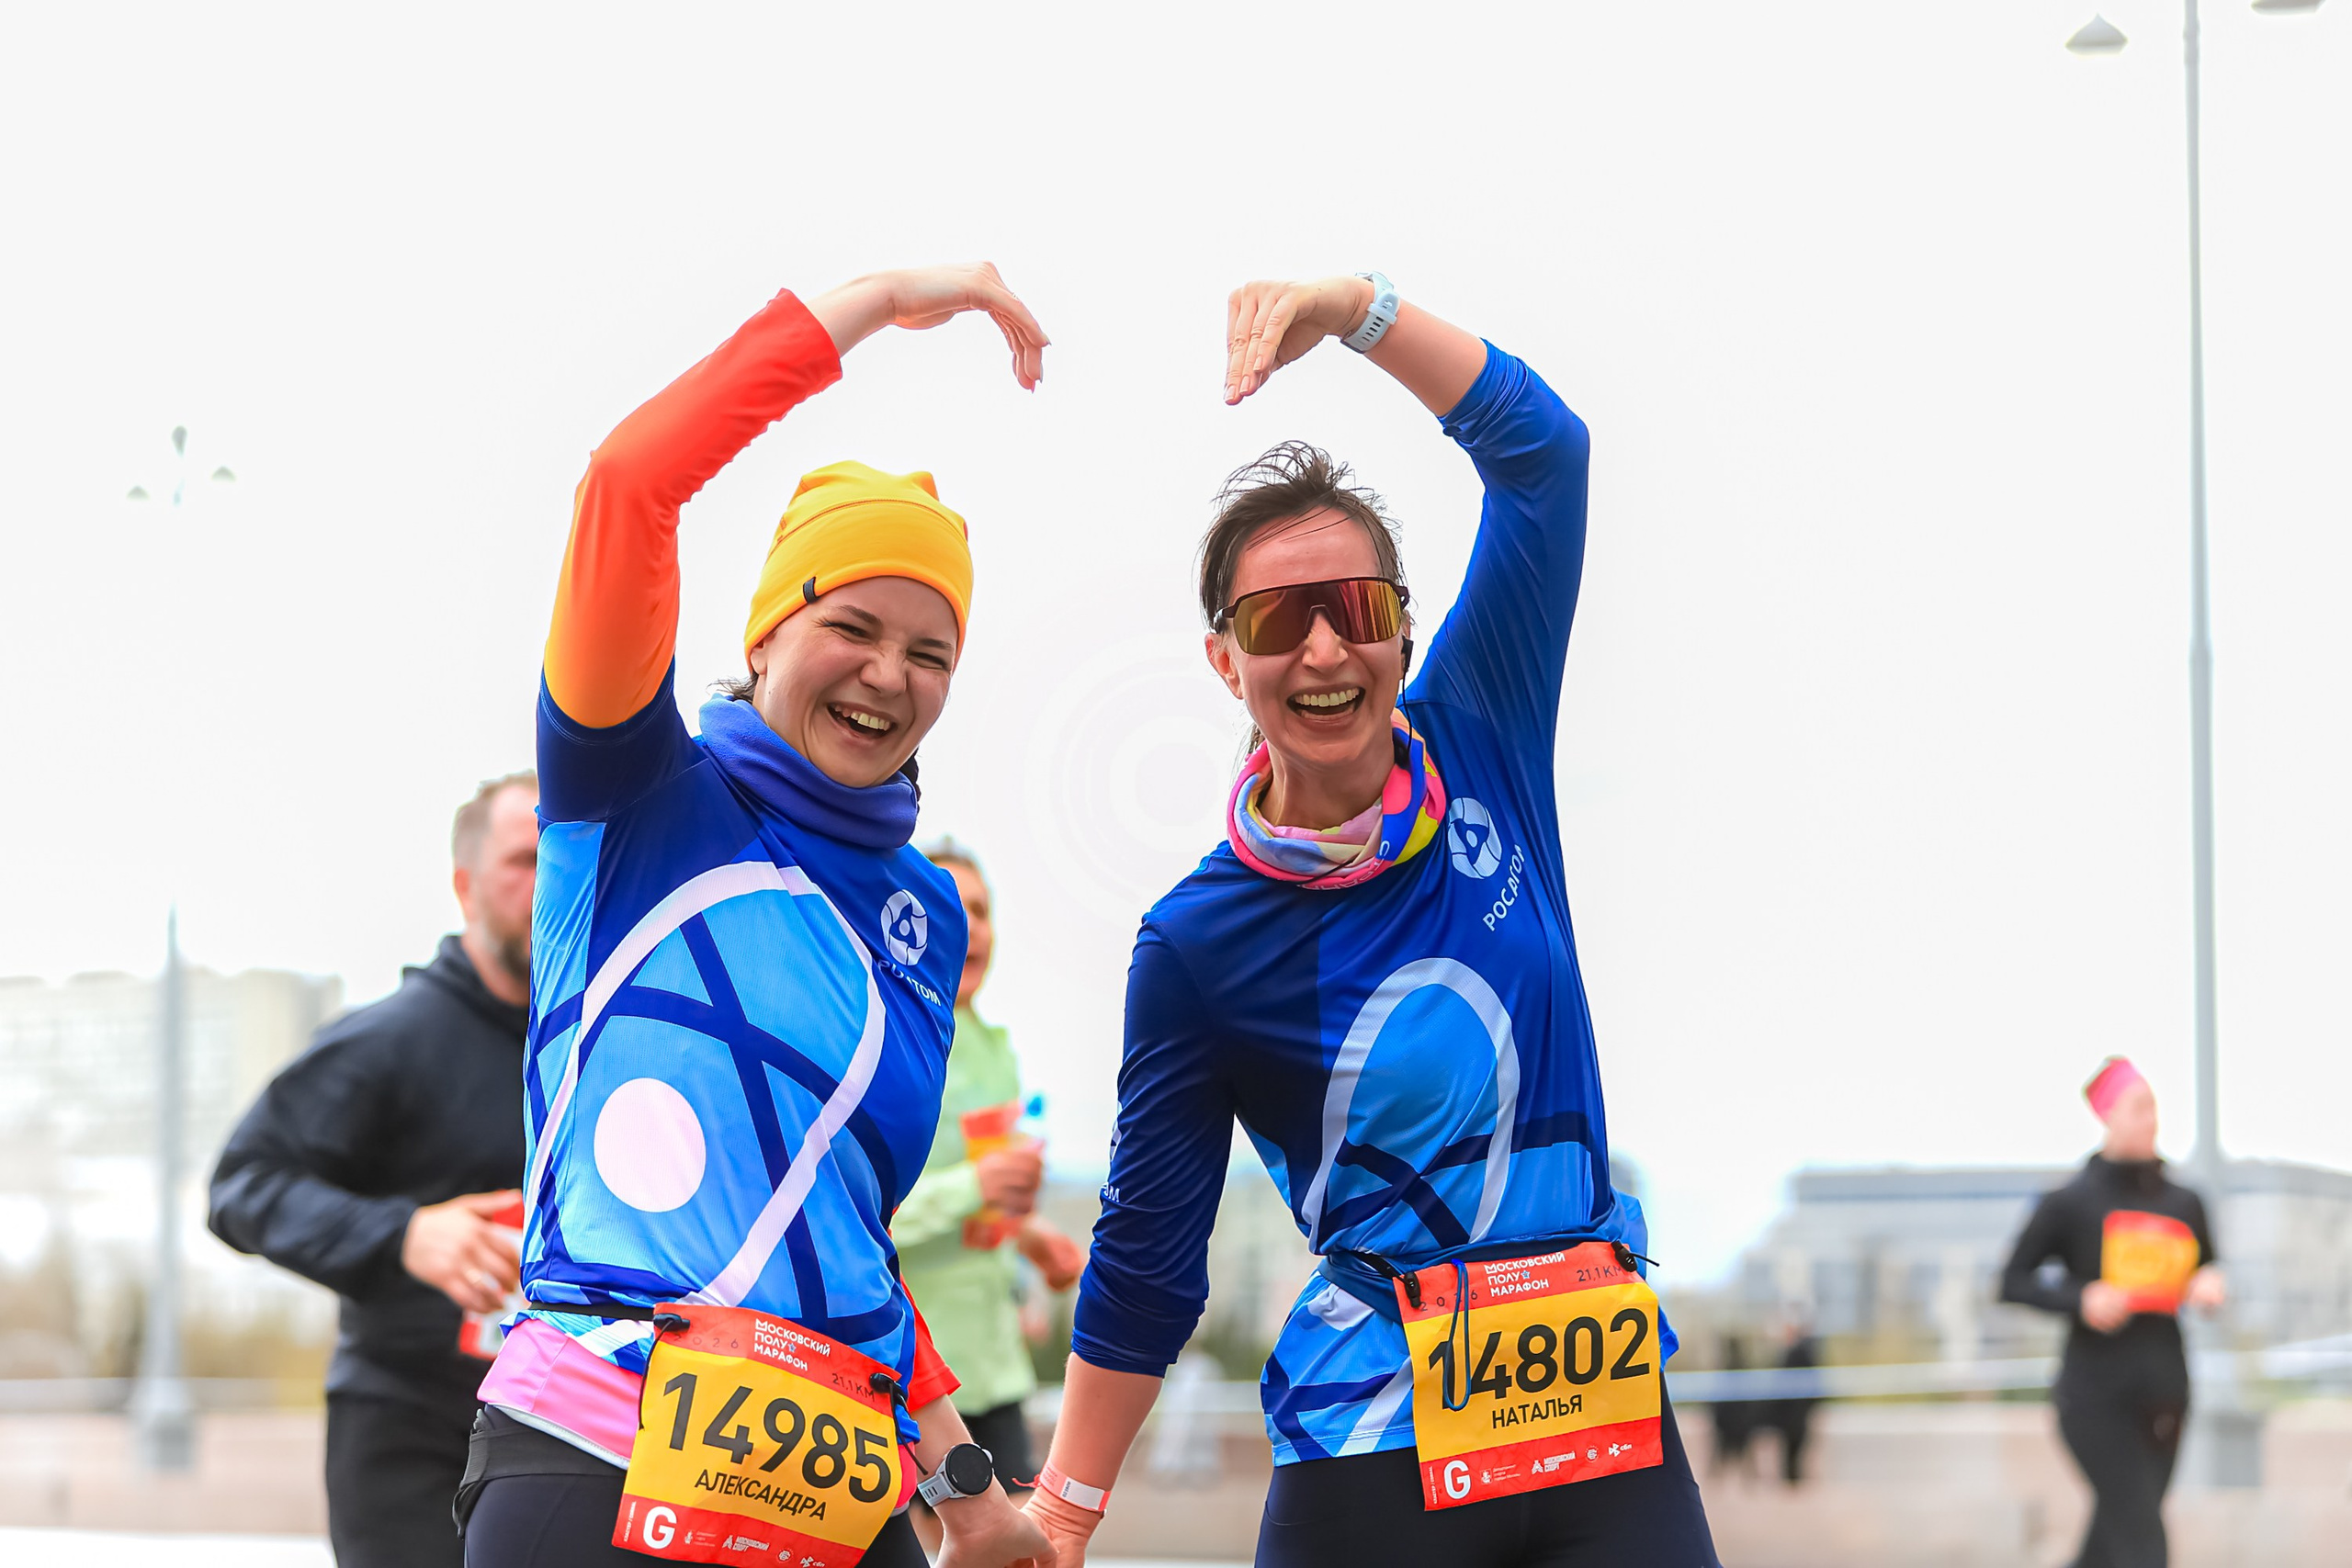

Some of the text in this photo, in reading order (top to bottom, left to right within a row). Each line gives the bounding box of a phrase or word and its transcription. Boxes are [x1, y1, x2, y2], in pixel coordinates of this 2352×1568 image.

[1484, 1252, 1566, 1274] МОСКОВСКИЙ
[1487, 1271, 1521, 1285] ПОЛУ
[1490, 1279, 1549, 1297] МАРАФОН
[754, 1332, 787, 1349] ПОЛУ
[755, 1318, 831, 1357] МОСКОВСКИЙ
[754, 1343, 808, 1371] МАРАФОН
[1428, 1308, 1650, 1410] 14802
[1492, 1394, 1583, 1429] НАТАЛЬЯ
[663, 1372, 891, 1503] 14985
[695, 1469, 828, 1521] АЛЕКСАНДРА
[1444, 1460, 1472, 1499] G
[643, 1506, 677, 1550] G
